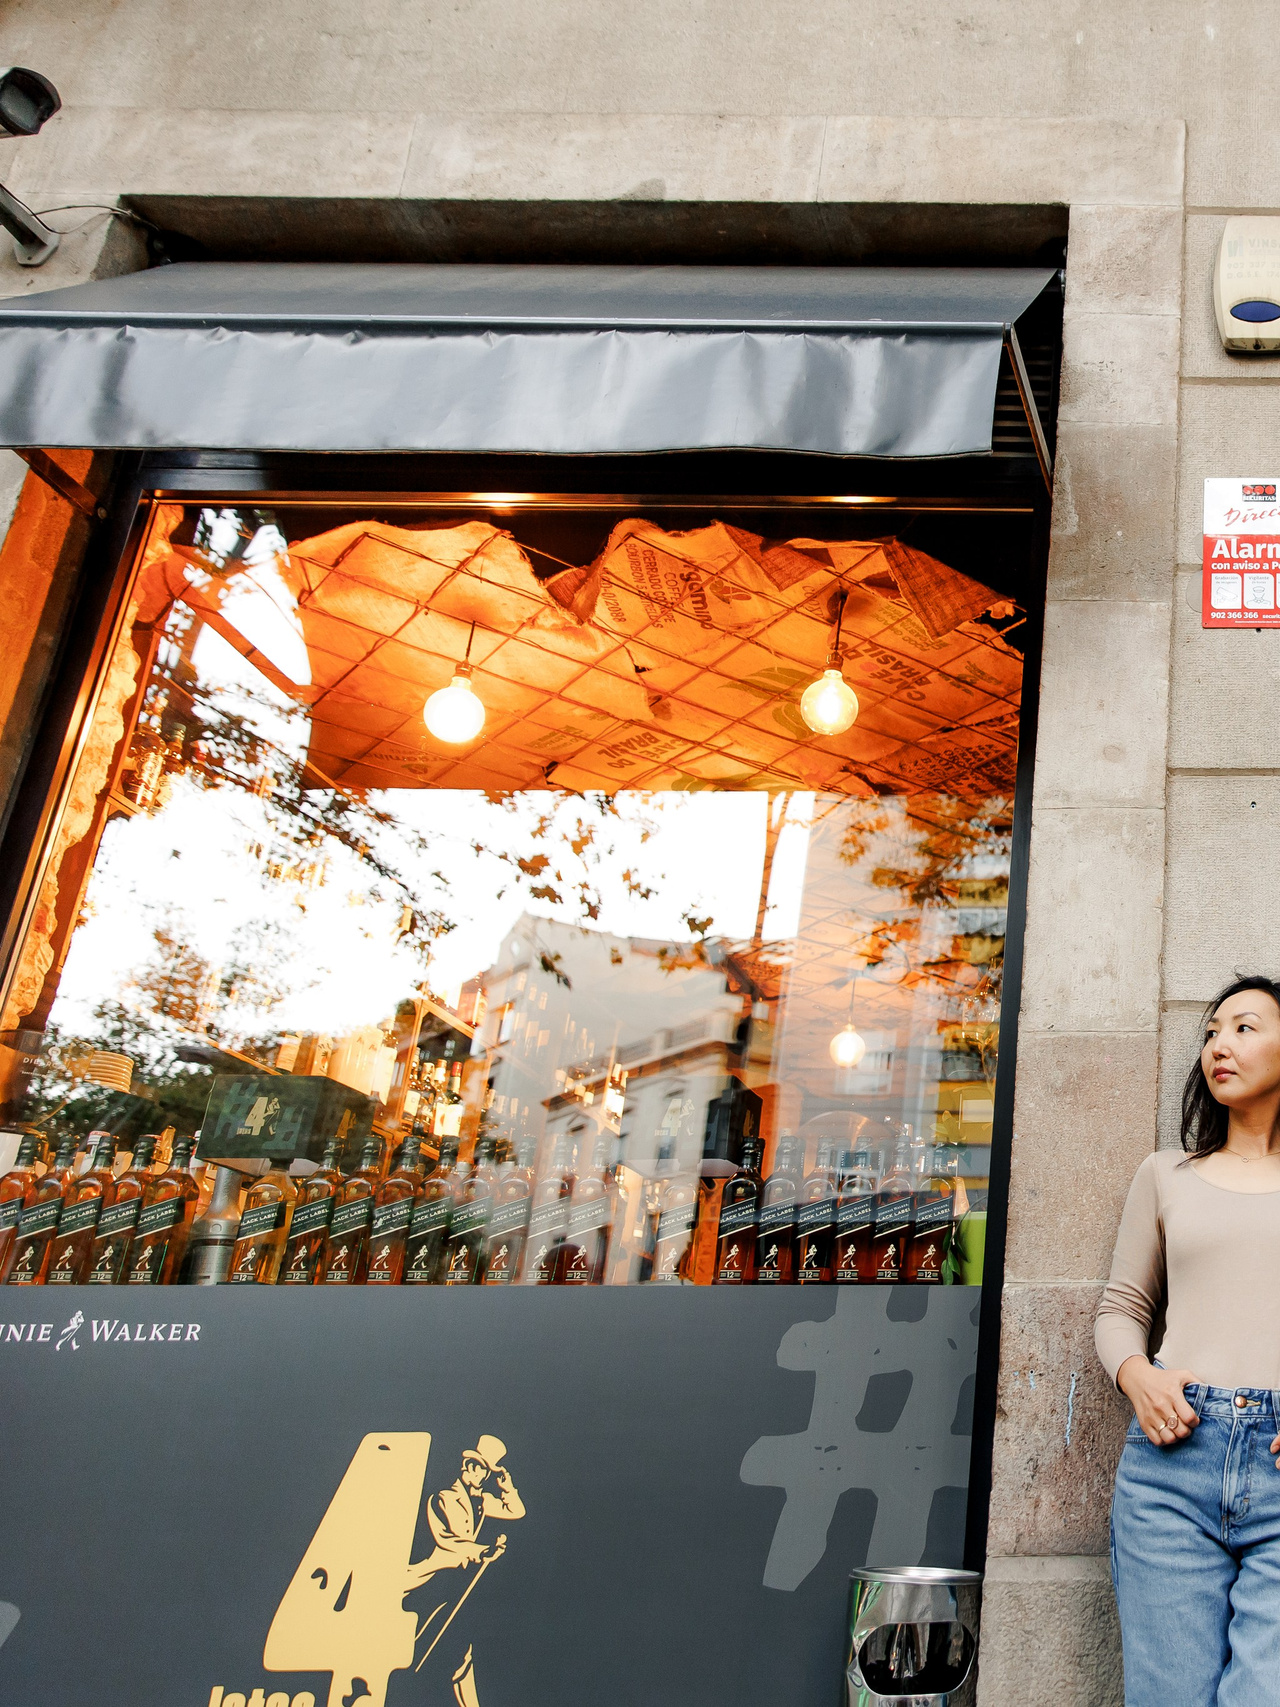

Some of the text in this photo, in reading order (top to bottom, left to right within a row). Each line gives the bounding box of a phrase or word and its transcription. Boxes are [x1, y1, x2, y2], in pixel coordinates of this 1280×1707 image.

[624, 543, 646, 584] BOURBON
[642, 549, 663, 590] CERRADO
[1211, 562, 1231, 571] con
[1232, 560, 1261, 571] aviso
[1262, 563, 1270, 571] a
[1210, 611, 1226, 619] 902
[1227, 611, 1243, 619] 366
[1243, 611, 1259, 619] 366
[596, 731, 662, 760] BRASIL
[17, 1273, 25, 1281] 12
[91, 1319, 202, 1342] WALKER
